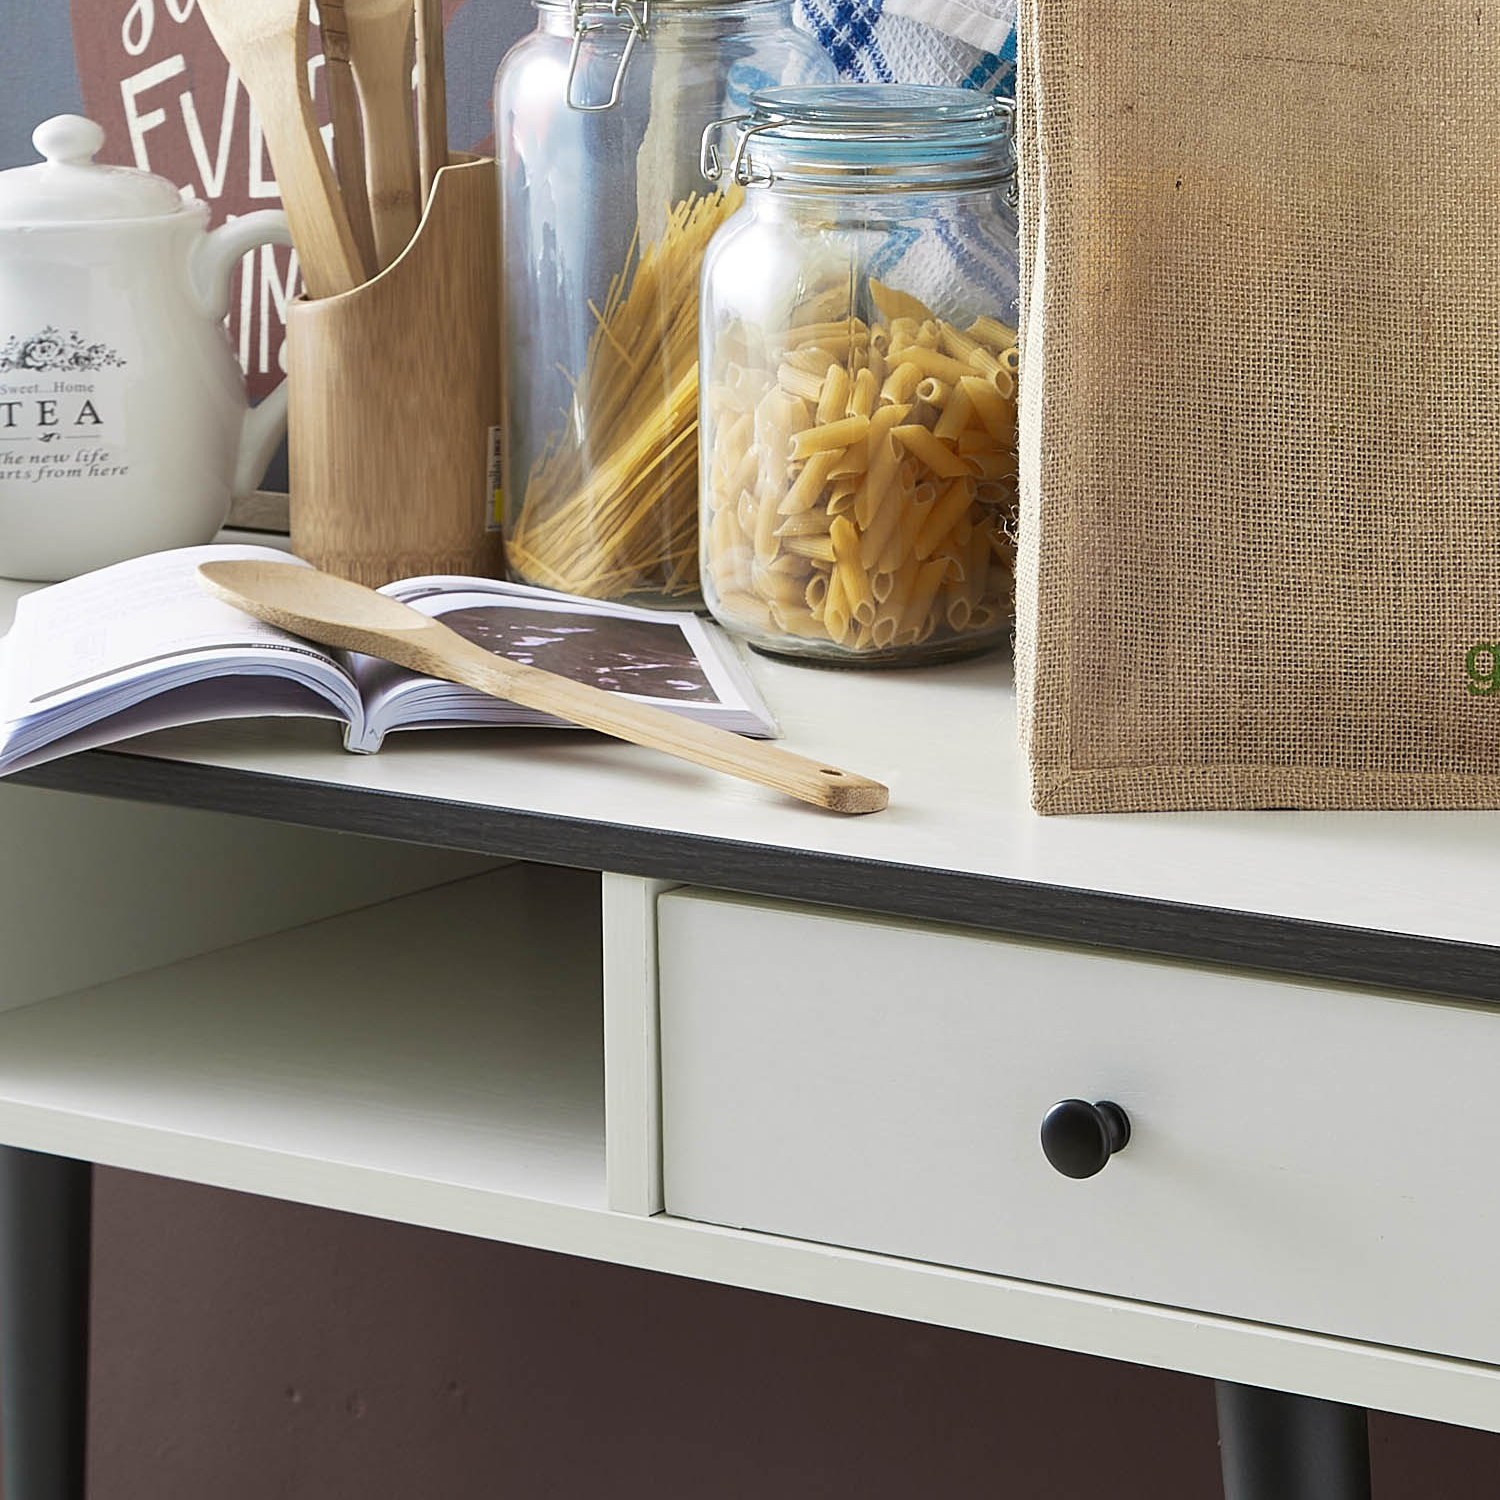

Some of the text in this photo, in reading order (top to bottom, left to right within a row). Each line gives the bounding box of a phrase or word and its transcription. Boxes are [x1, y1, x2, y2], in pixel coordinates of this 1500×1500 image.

[0, 399, 104, 428] TEA
[29, 454, 70, 464] new
[75, 448, 110, 467] life
[31, 465, 82, 483] from
[88, 463, 128, 477] here
